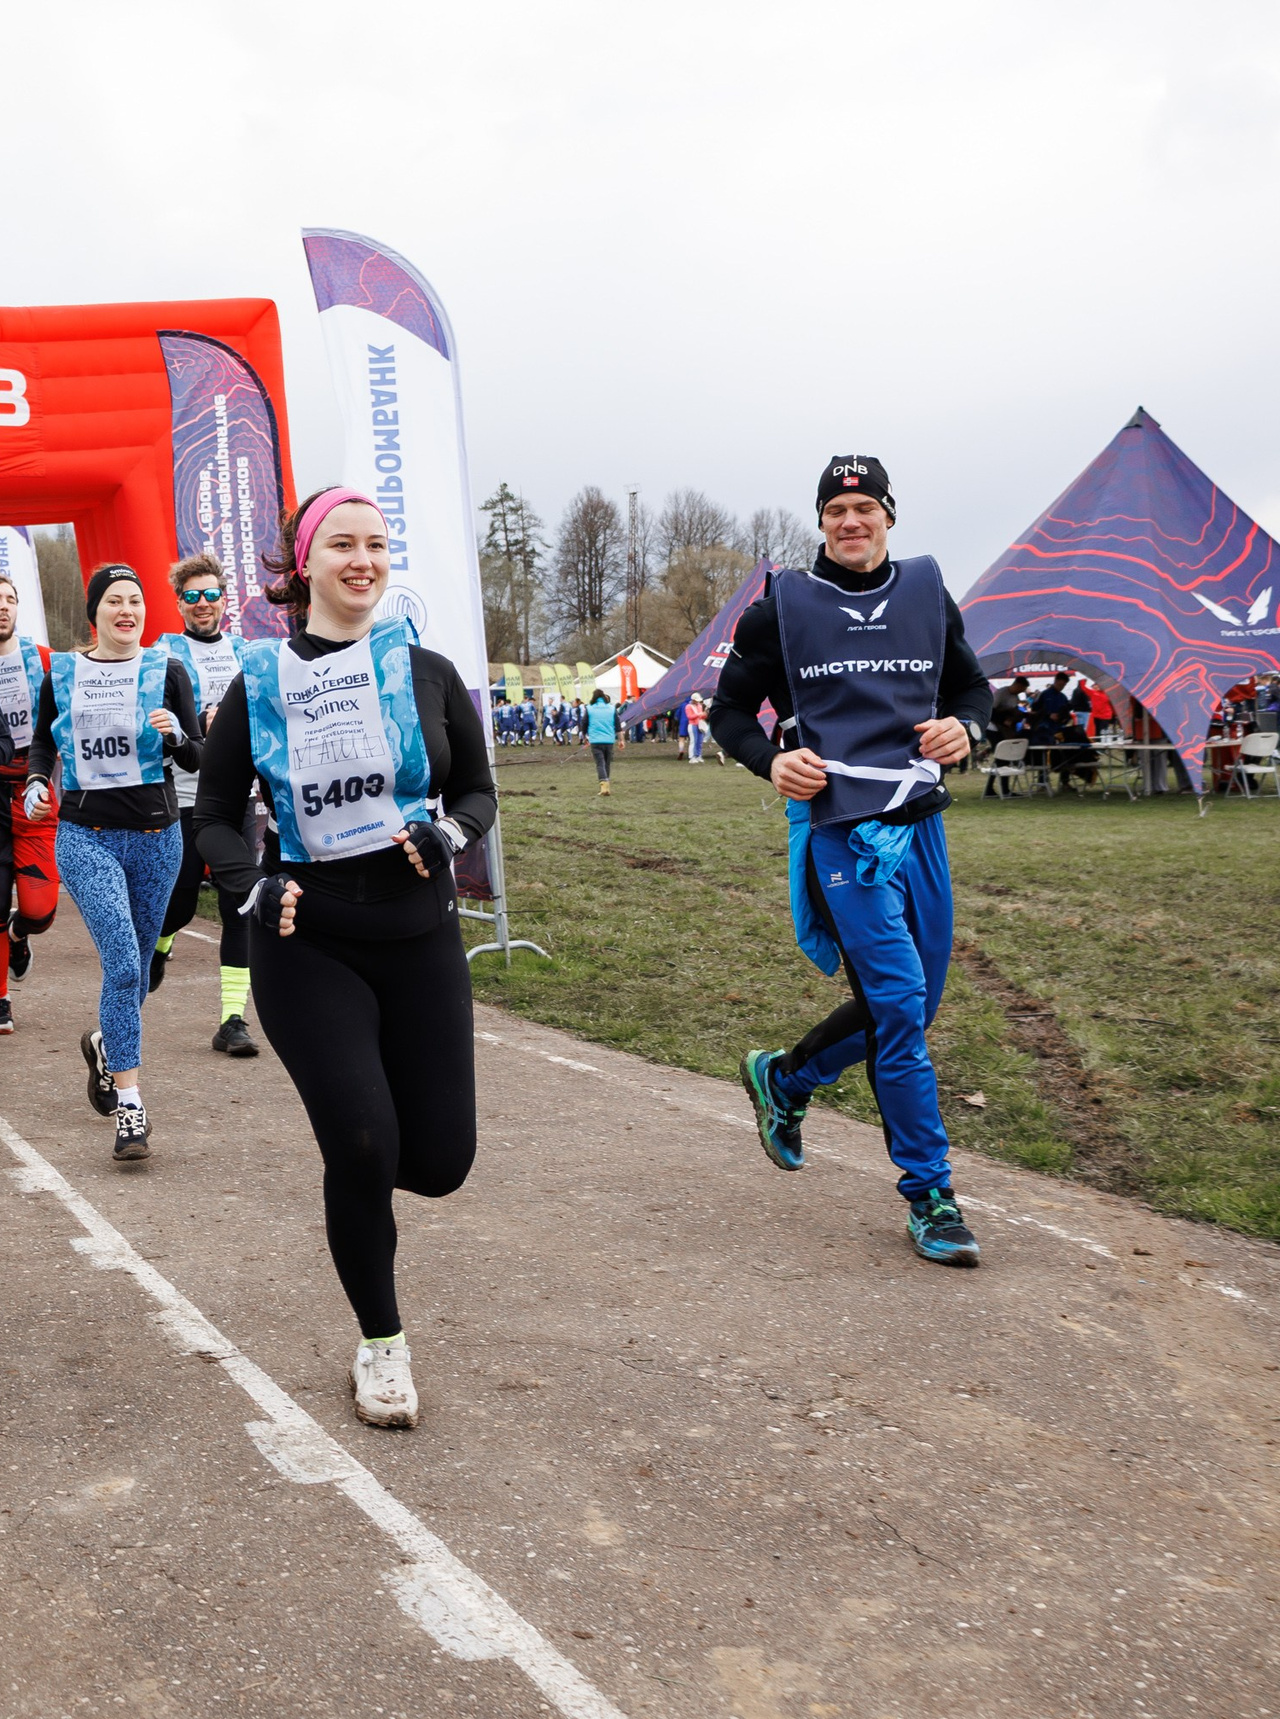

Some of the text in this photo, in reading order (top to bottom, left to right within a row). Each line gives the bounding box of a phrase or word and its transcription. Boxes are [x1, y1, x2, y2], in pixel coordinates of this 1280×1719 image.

[832, 459, 869, 477] DNB
[204, 664, 232, 673] Sminex
[799, 658, 934, 680] ИНСТРУКТОР
[78, 677, 134, 687] ГОНКА ГЕРОЕВ
[286, 672, 370, 702] ГОНКА ГЕРОЕВ
[83, 689, 125, 700] Sminex
[303, 698, 360, 724] Sminex
[81, 736, 131, 761] 5405
[301, 773, 385, 818] 5403
[336, 820, 386, 841] ГАЗПРОМБАНК
